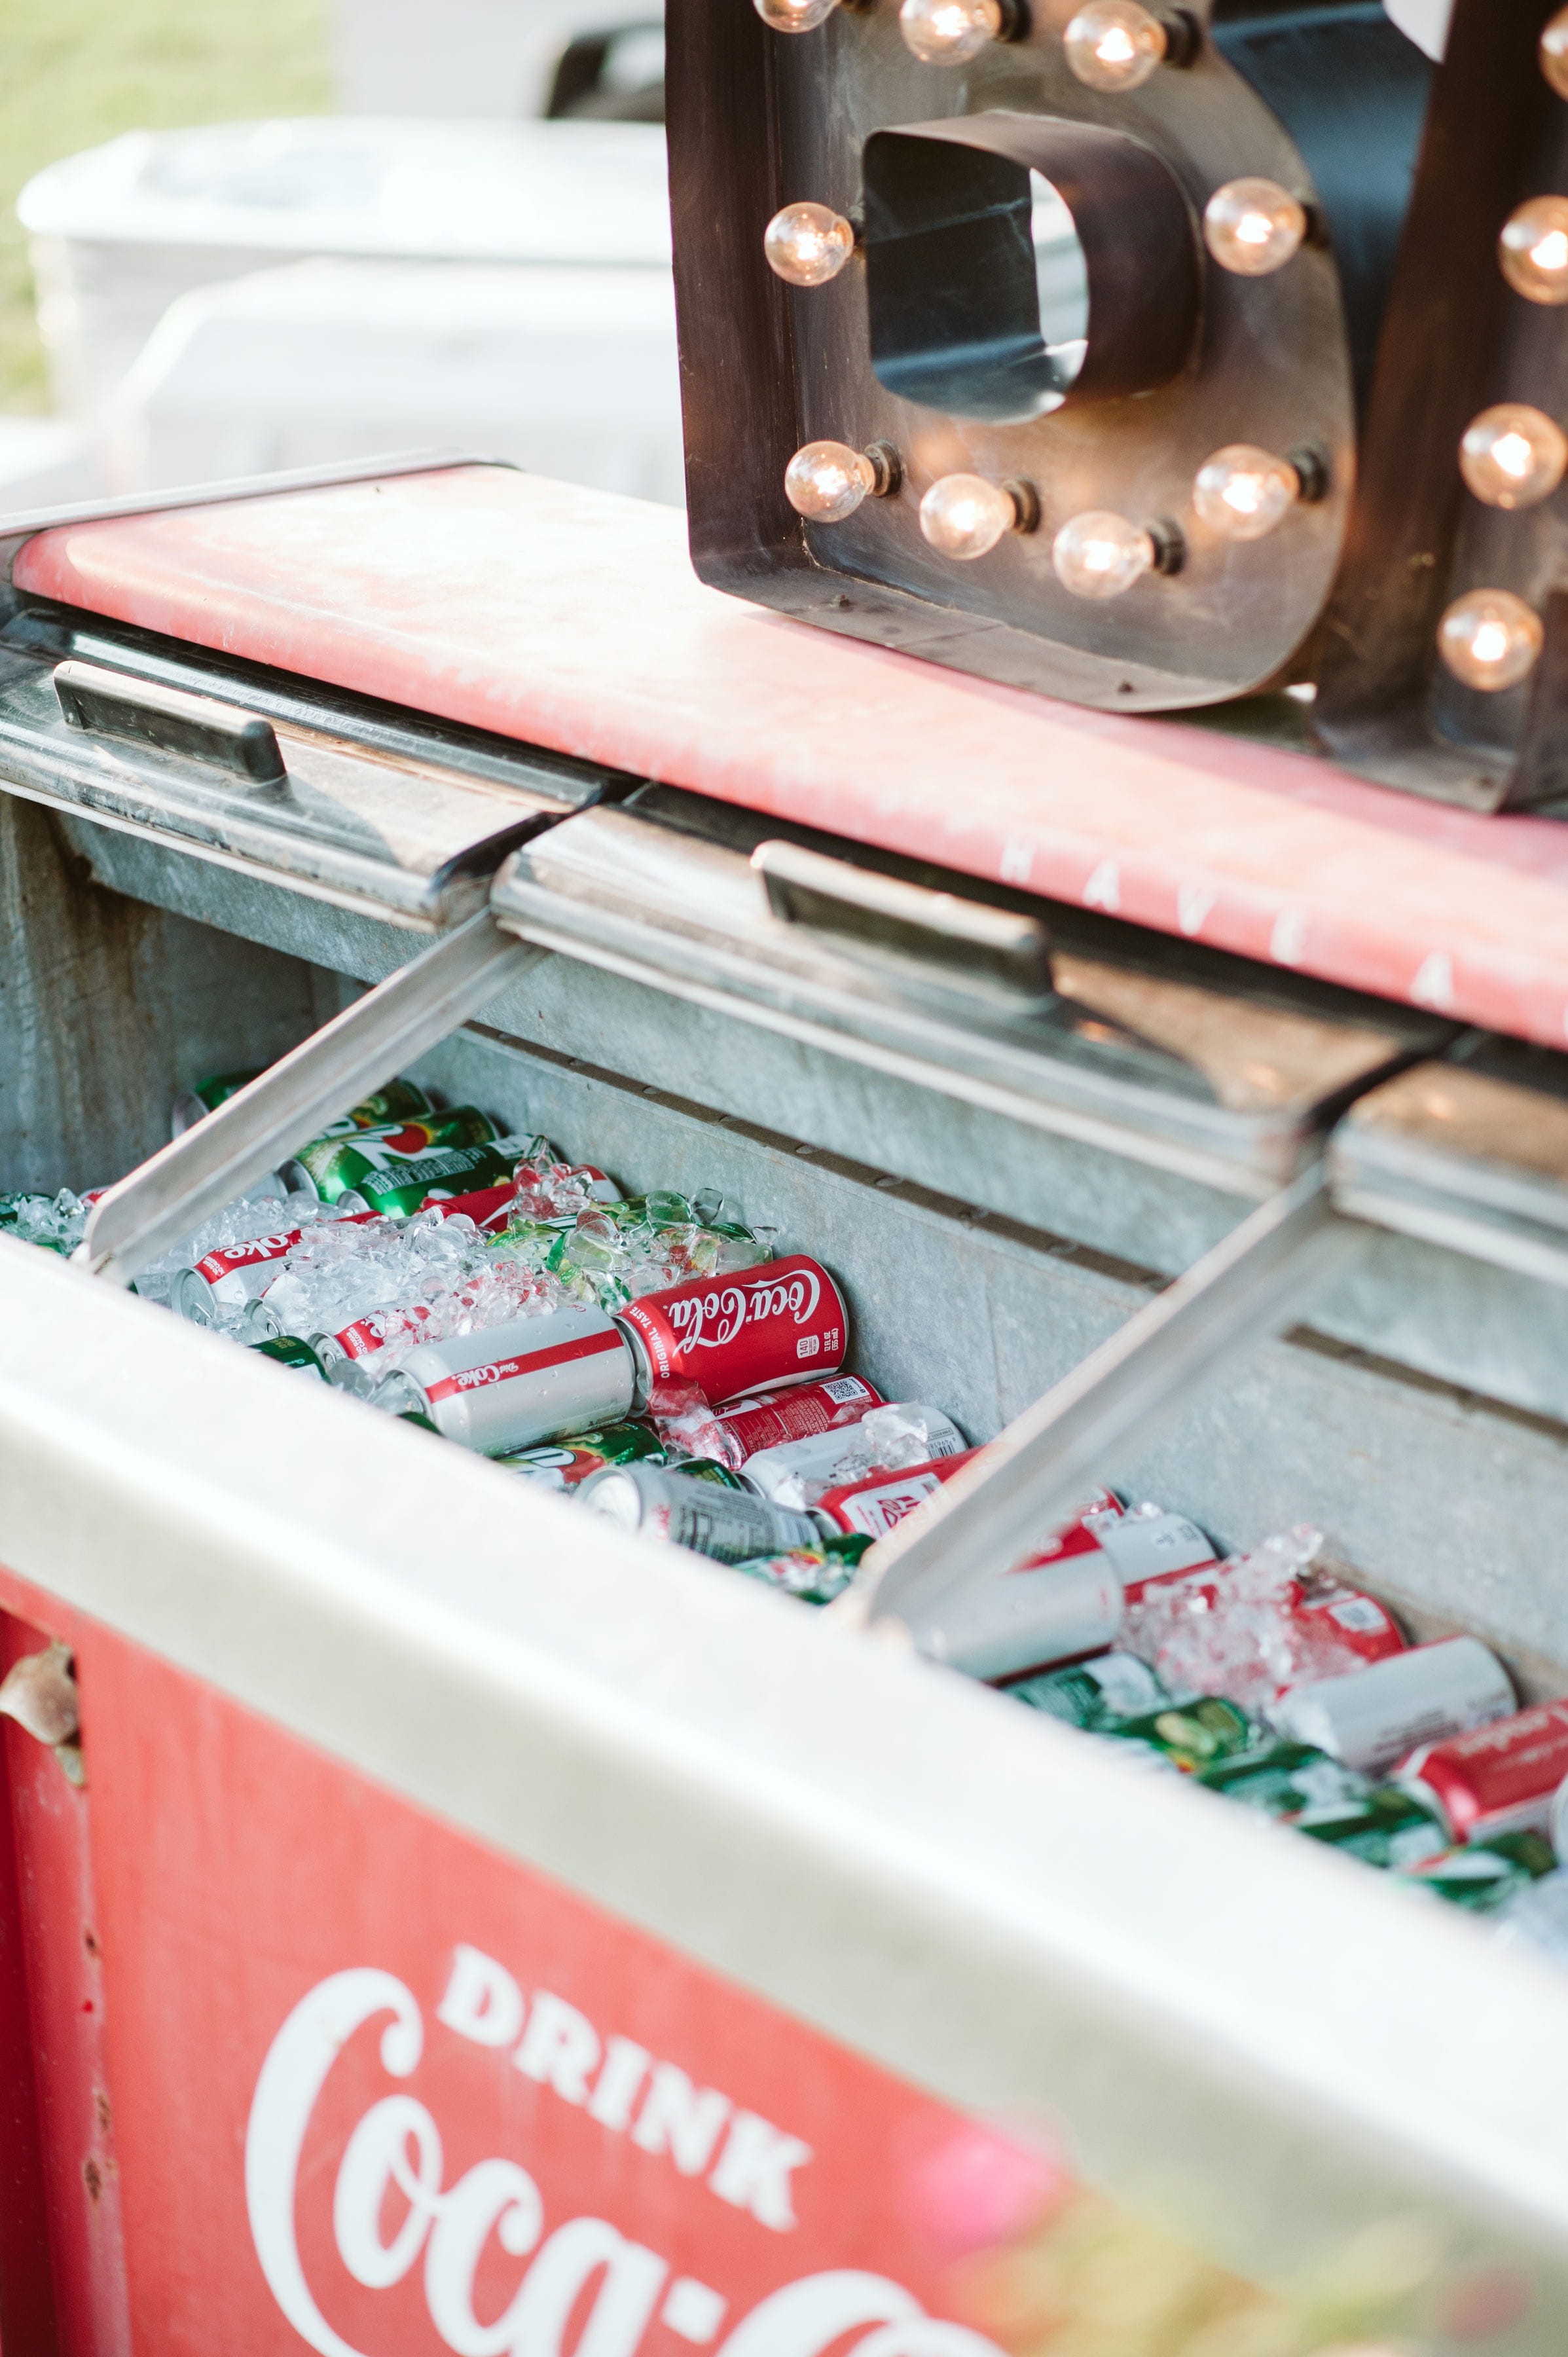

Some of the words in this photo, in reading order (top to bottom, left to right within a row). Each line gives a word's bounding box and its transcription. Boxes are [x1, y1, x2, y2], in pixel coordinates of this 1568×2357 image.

[997, 832, 1309, 966] HAVE
[1409, 951, 1455, 1010] A
[630, 1306, 651, 1328] TASTE
[668, 1270, 820, 1358] Coca-Cola
[824, 1331, 831, 1340] OZ
[648, 1330, 670, 1379] ORIGINAL
[799, 1340, 809, 1356] 140
[435, 1942, 816, 2234] DRINK
